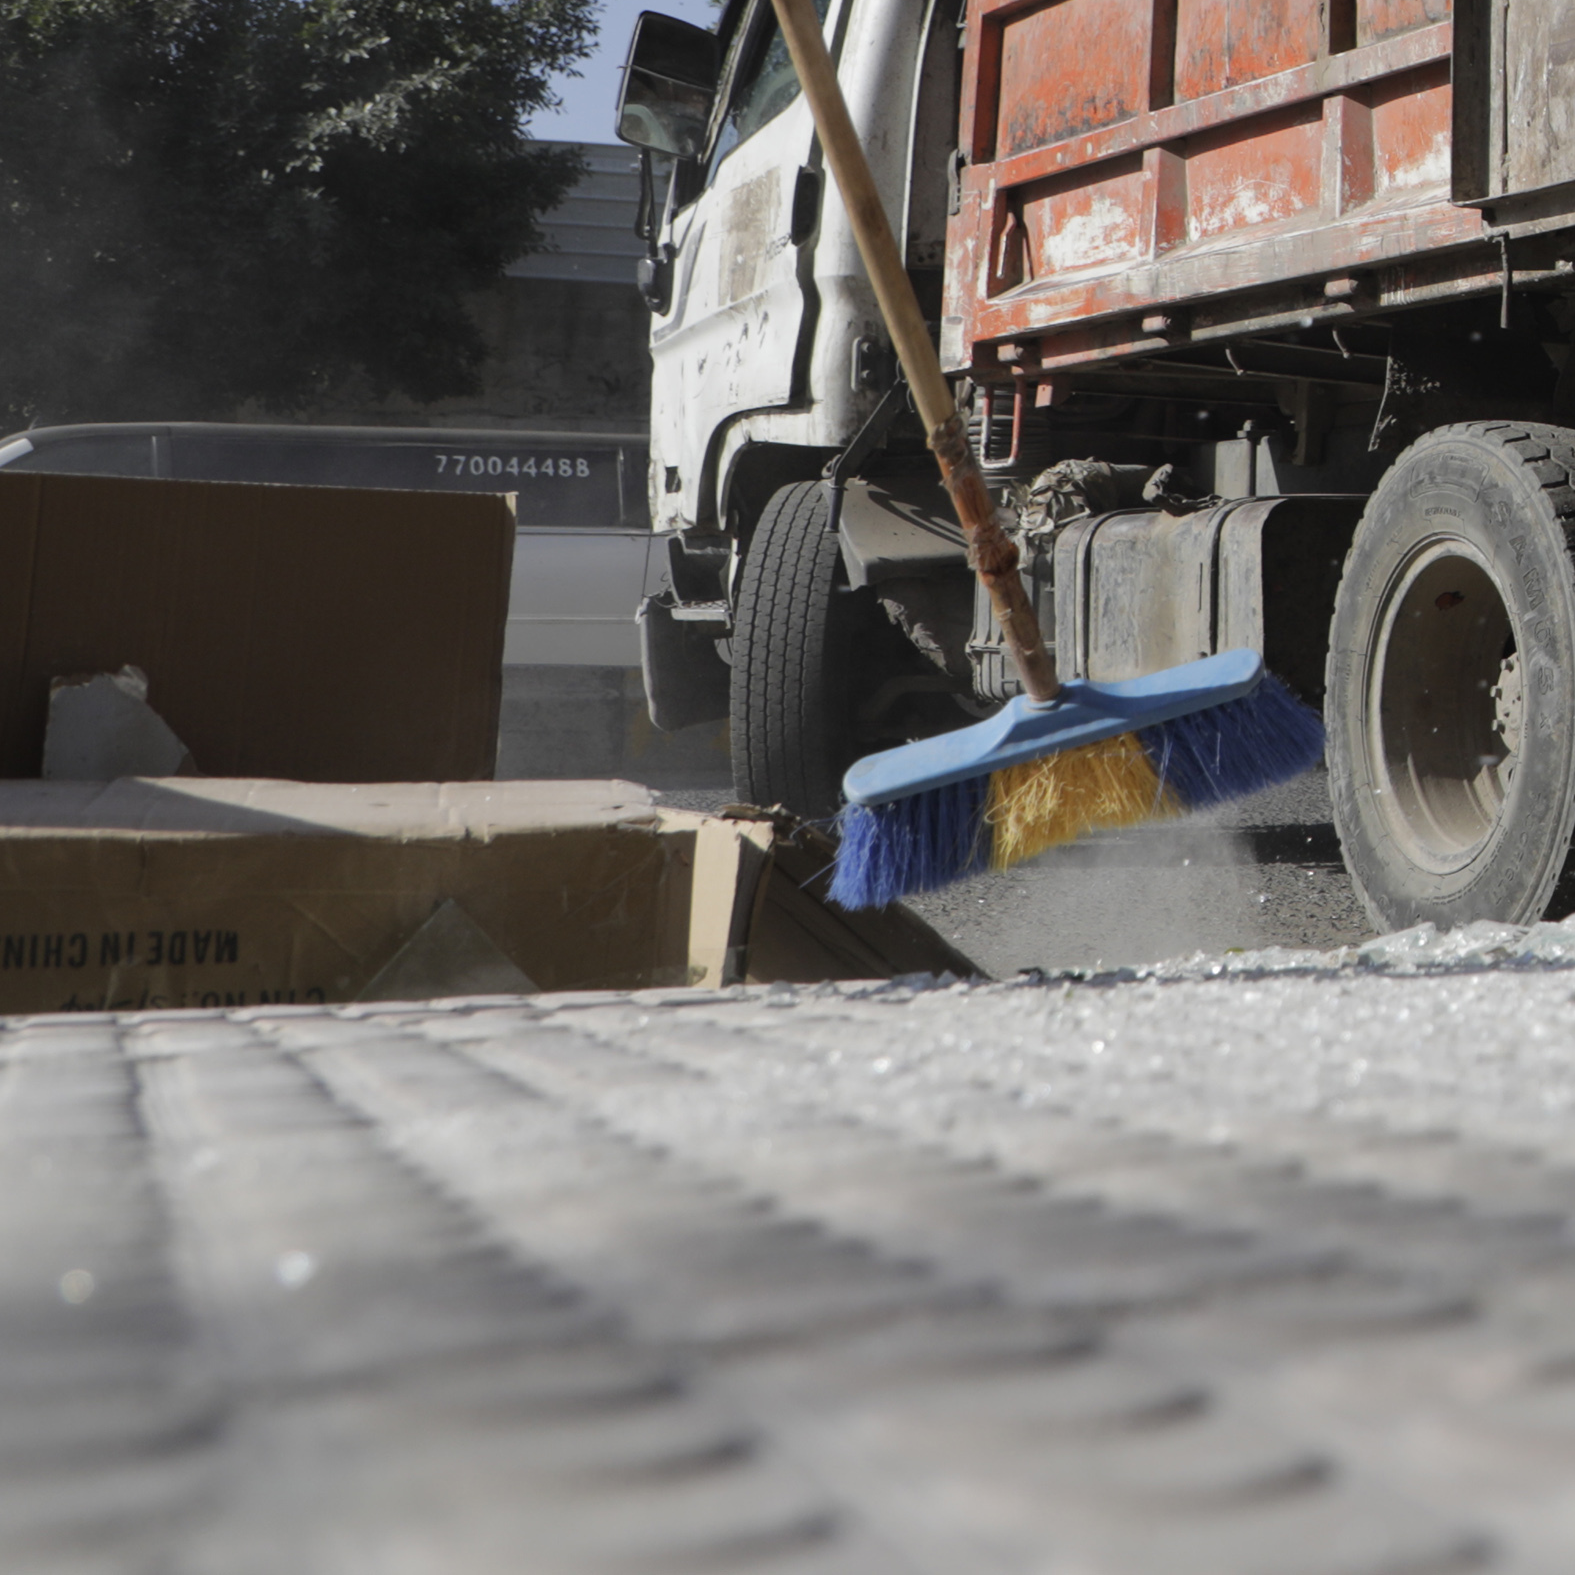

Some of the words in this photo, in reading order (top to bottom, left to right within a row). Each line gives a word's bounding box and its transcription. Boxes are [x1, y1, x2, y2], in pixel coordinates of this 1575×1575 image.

[0, 933, 88, 970] CHIN
[101, 931, 137, 967] IN
[146, 930, 240, 967] MADE
